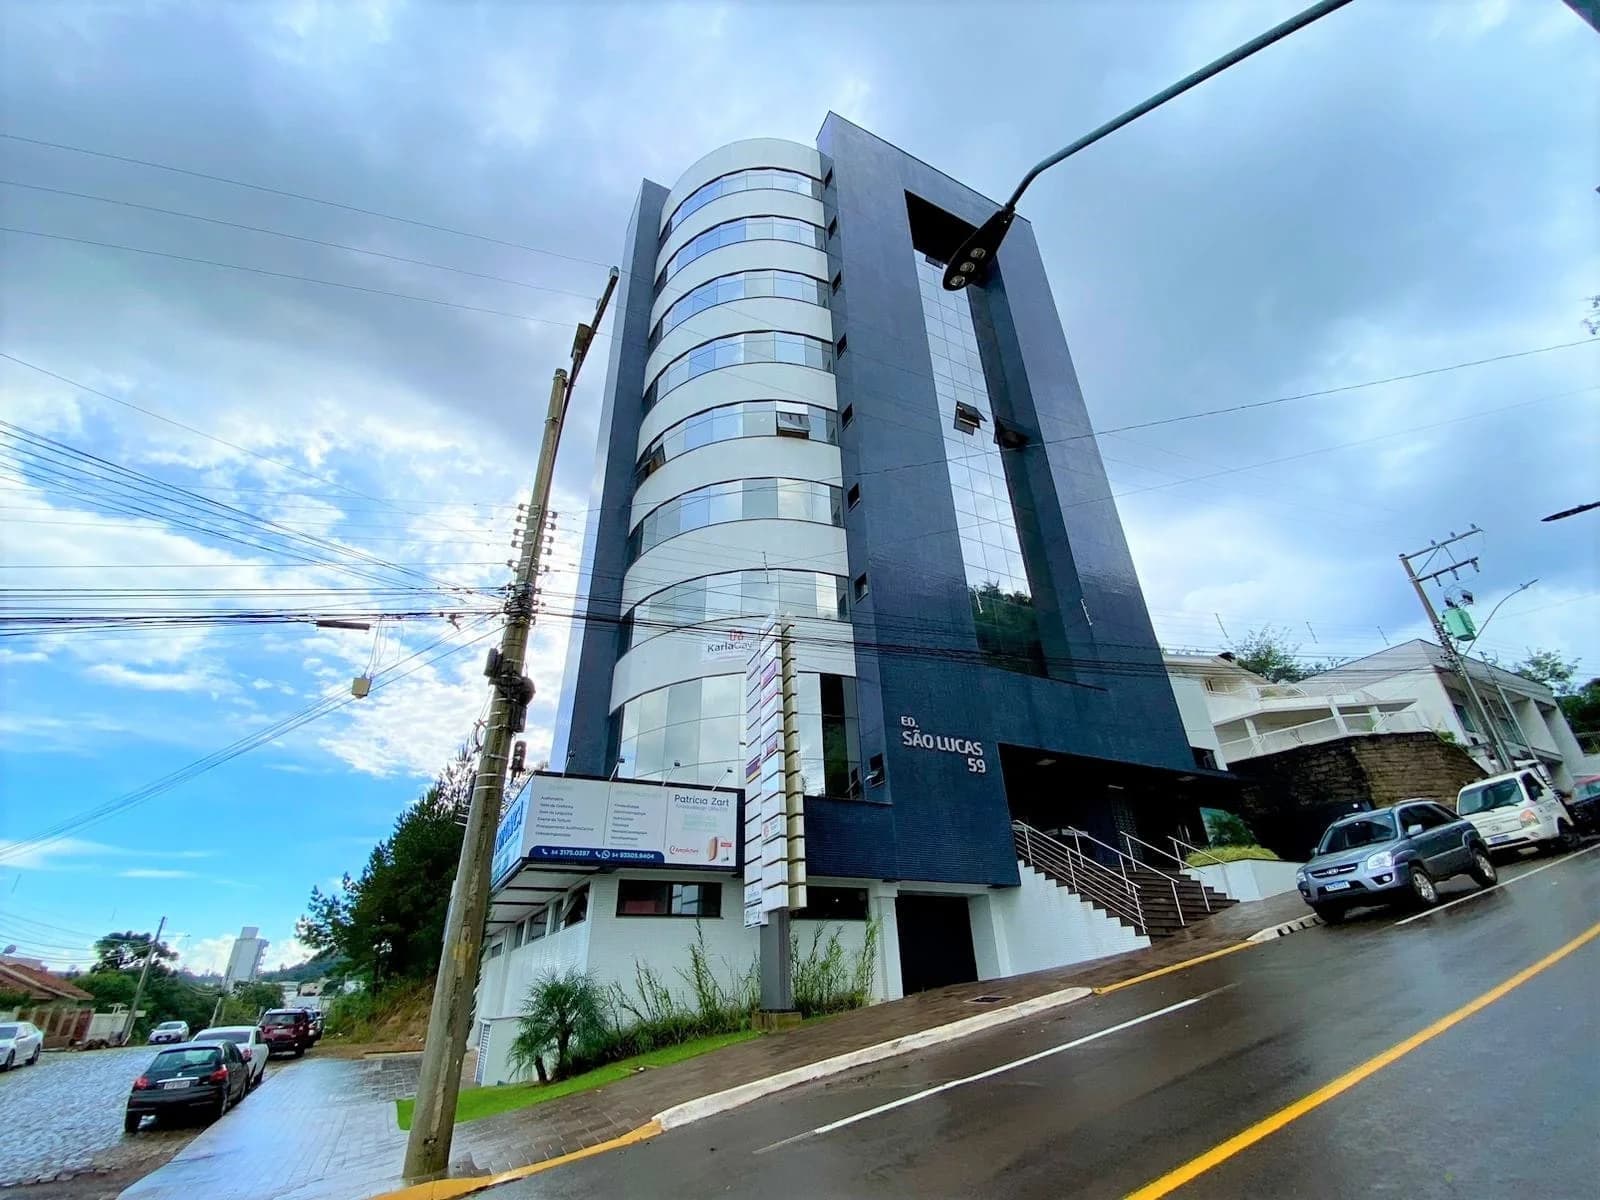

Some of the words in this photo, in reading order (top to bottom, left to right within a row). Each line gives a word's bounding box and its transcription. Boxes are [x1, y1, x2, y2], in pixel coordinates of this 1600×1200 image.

[902, 729, 934, 749] SÃO
[936, 735, 984, 756] LUCAS
[967, 757, 986, 773] 59
[711, 796, 730, 807] Zart
